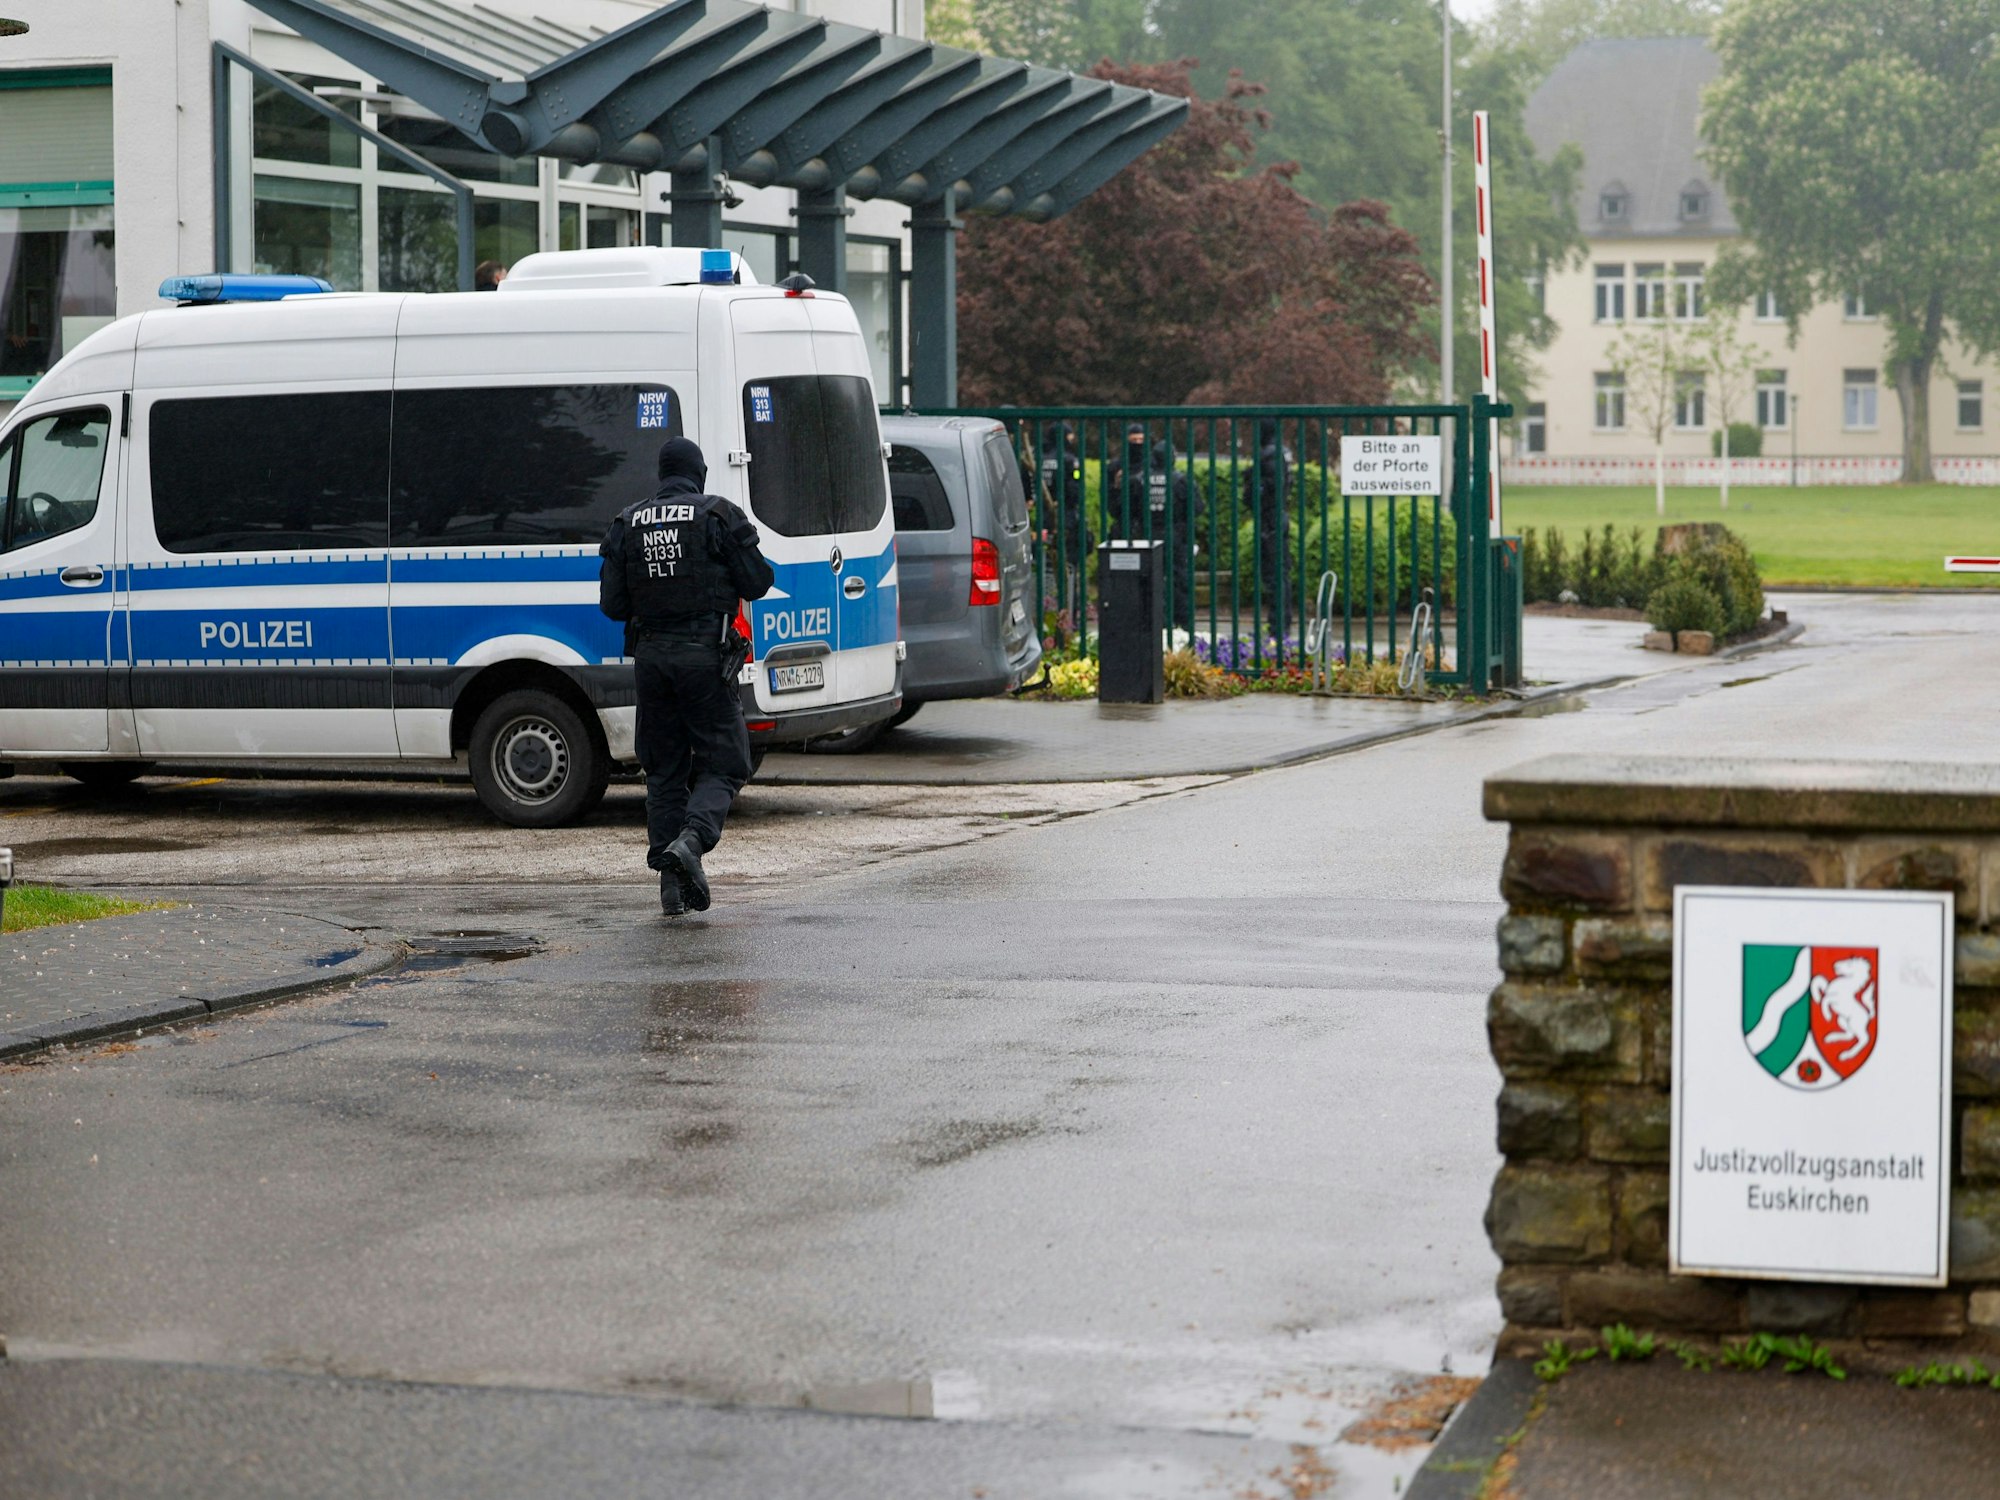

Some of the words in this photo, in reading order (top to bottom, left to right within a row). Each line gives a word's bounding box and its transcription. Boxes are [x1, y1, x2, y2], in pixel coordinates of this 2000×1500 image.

[639, 392, 667, 404] NRW
[751, 386, 769, 398] NRW
[643, 404, 662, 416] 313
[755, 399, 769, 410] 313
[640, 416, 664, 428] BAT
[755, 411, 770, 422] BAT
[1362, 440, 1397, 453] Bitte
[1402, 443, 1420, 453] an
[1353, 460, 1378, 472] der
[1383, 459, 1429, 472] Pforte
[1350, 479, 1431, 491] ausweisen
[631, 505, 695, 527] POLIZEI
[643, 528, 679, 547] NRW
[643, 543, 682, 562] 31331
[648, 561, 677, 578] FLT
[763, 607, 831, 641] POLIZEI
[200, 621, 313, 648] POLIZEI
[1694, 1148, 1924, 1182] Justizvollzugsanstalt
[1747, 1184, 1870, 1214] Euskirchen
